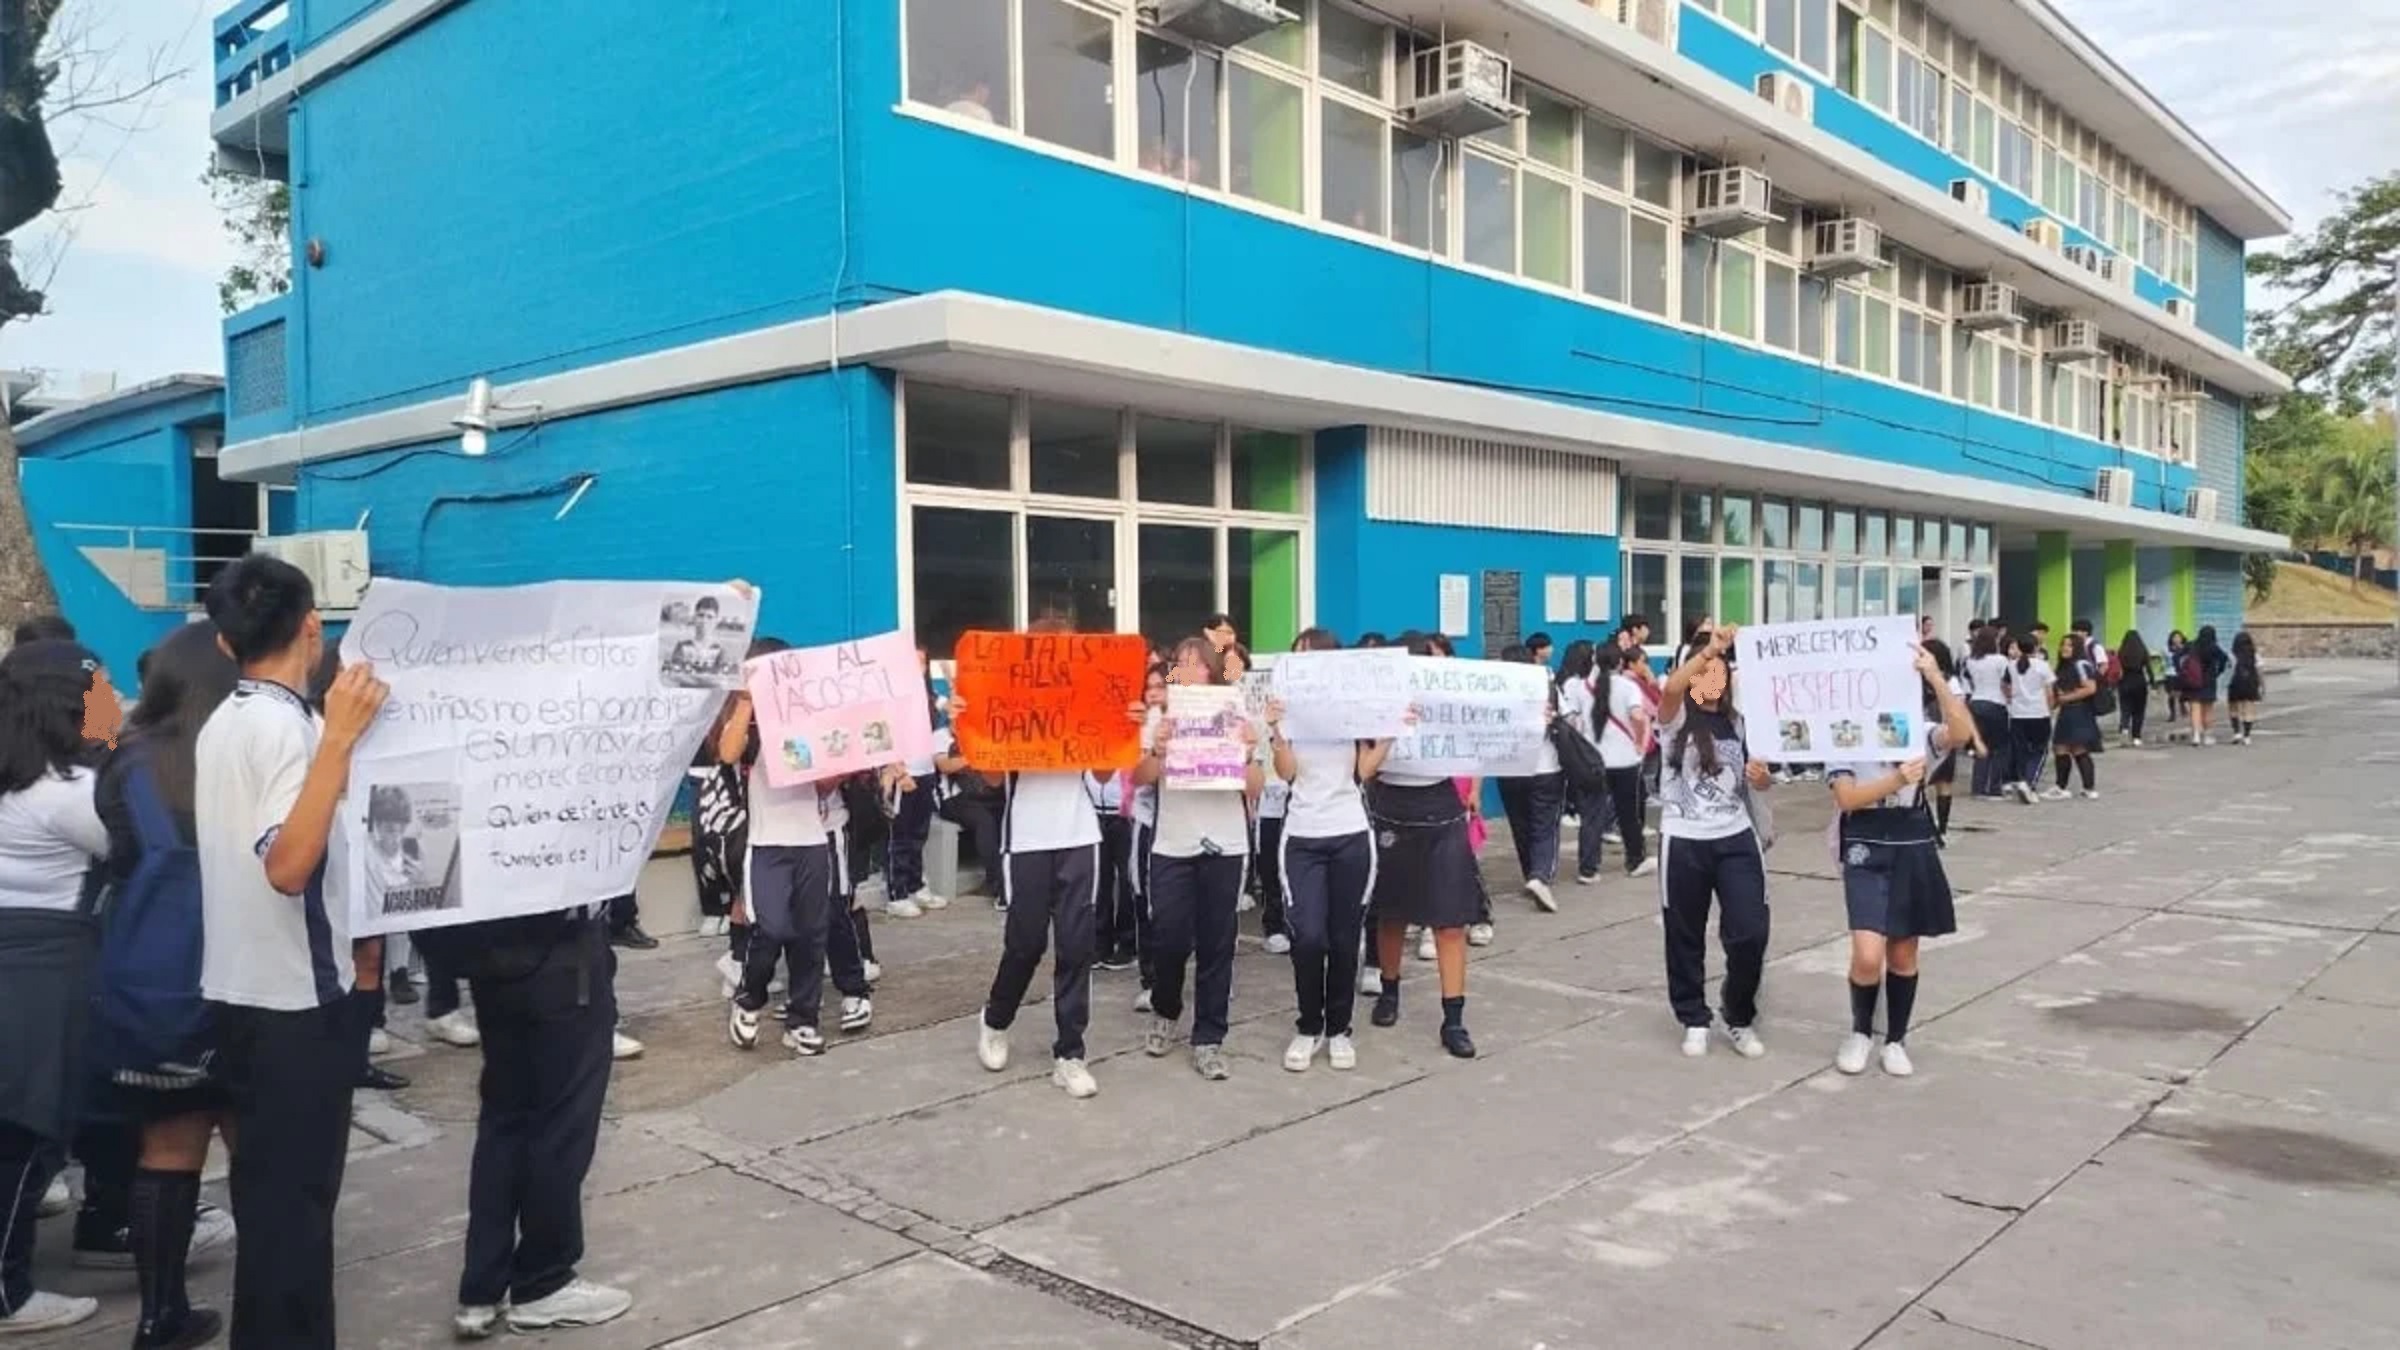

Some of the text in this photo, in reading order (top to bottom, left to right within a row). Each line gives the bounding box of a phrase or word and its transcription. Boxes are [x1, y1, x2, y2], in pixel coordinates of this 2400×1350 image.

[1755, 625, 1878, 660] MERECEMOS
[770, 642, 877, 686] NO AL
[494, 698, 531, 724] no
[538, 698, 575, 724] es
[1771, 668, 1881, 716] RESPETO
